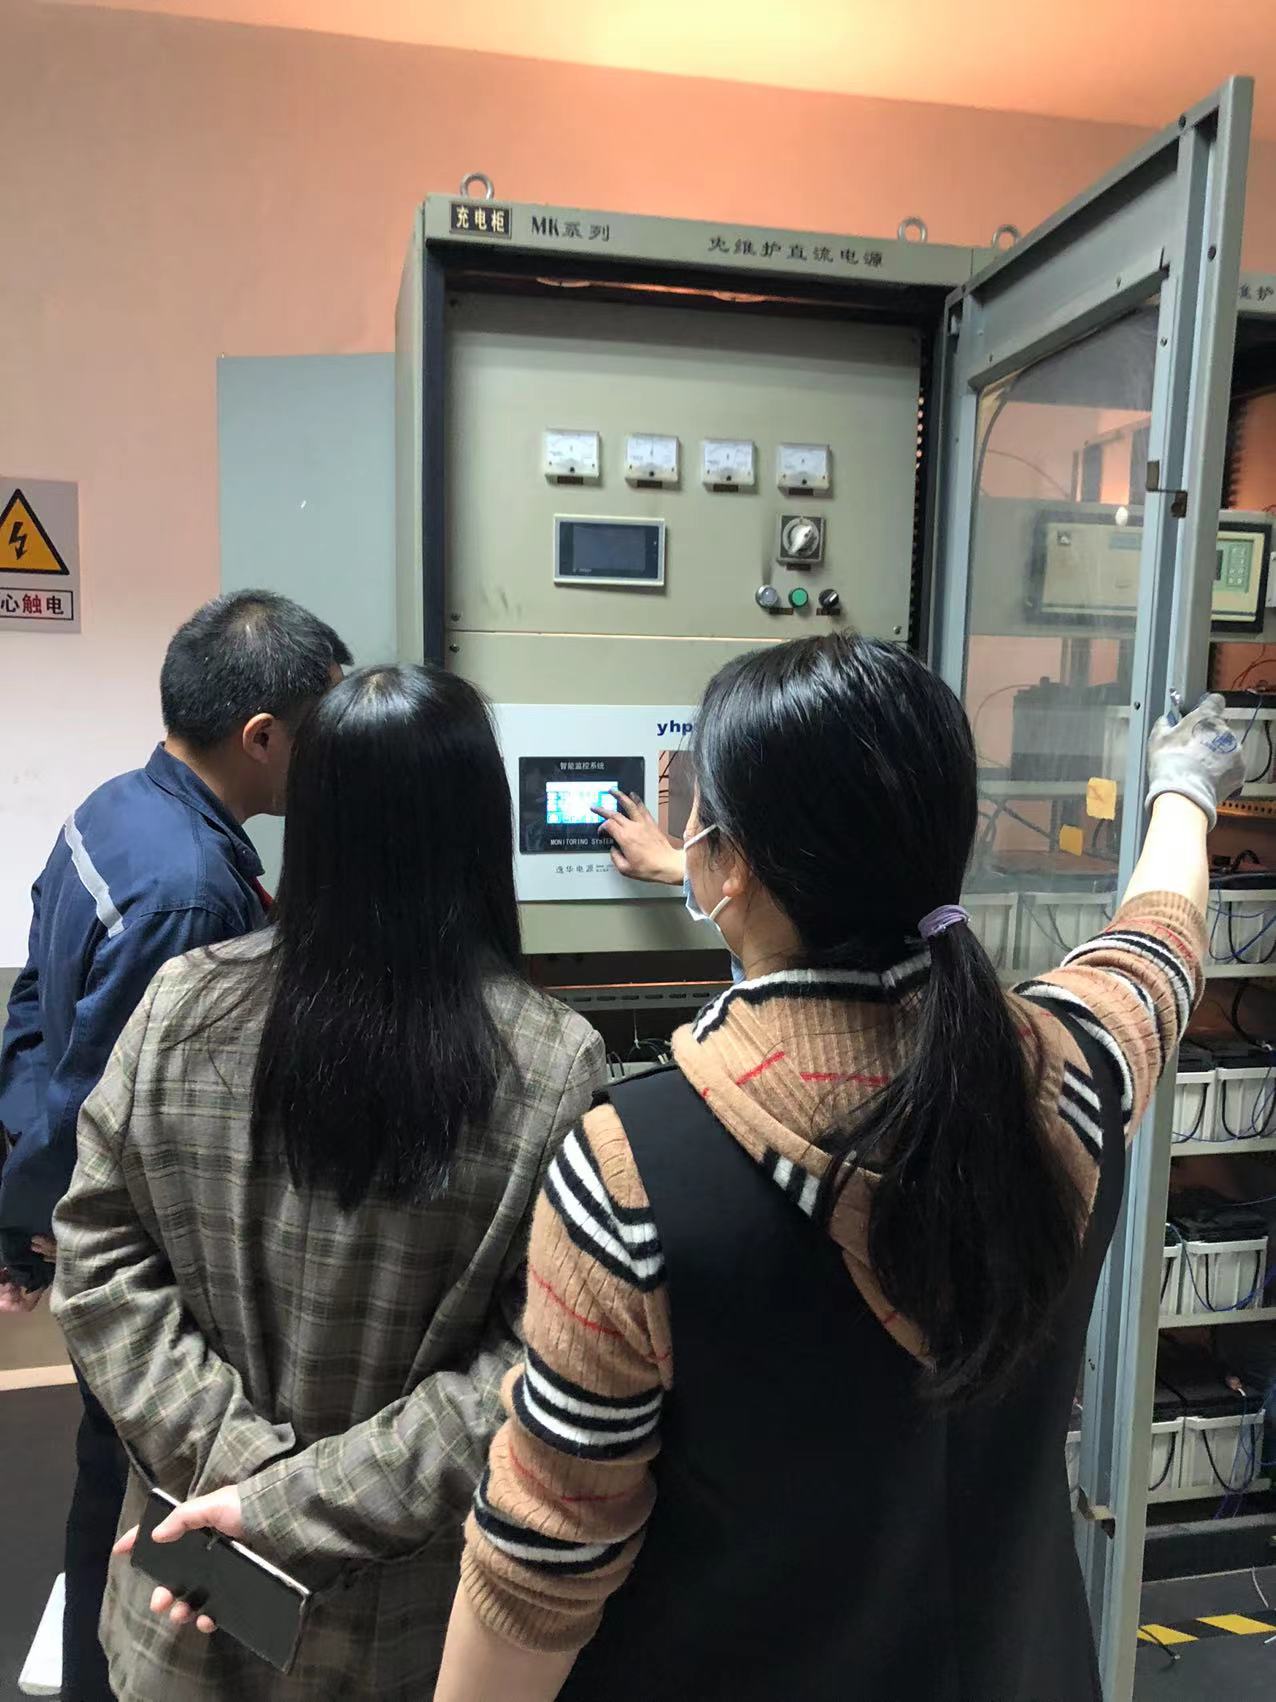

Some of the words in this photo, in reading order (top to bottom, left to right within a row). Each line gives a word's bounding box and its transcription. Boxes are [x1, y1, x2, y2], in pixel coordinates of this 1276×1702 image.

[456, 205, 505, 232] 充电柜
[0, 593, 64, 615] 心触电
[560, 761, 605, 771] 智能监控系统
[550, 838, 589, 846] MONITORING
